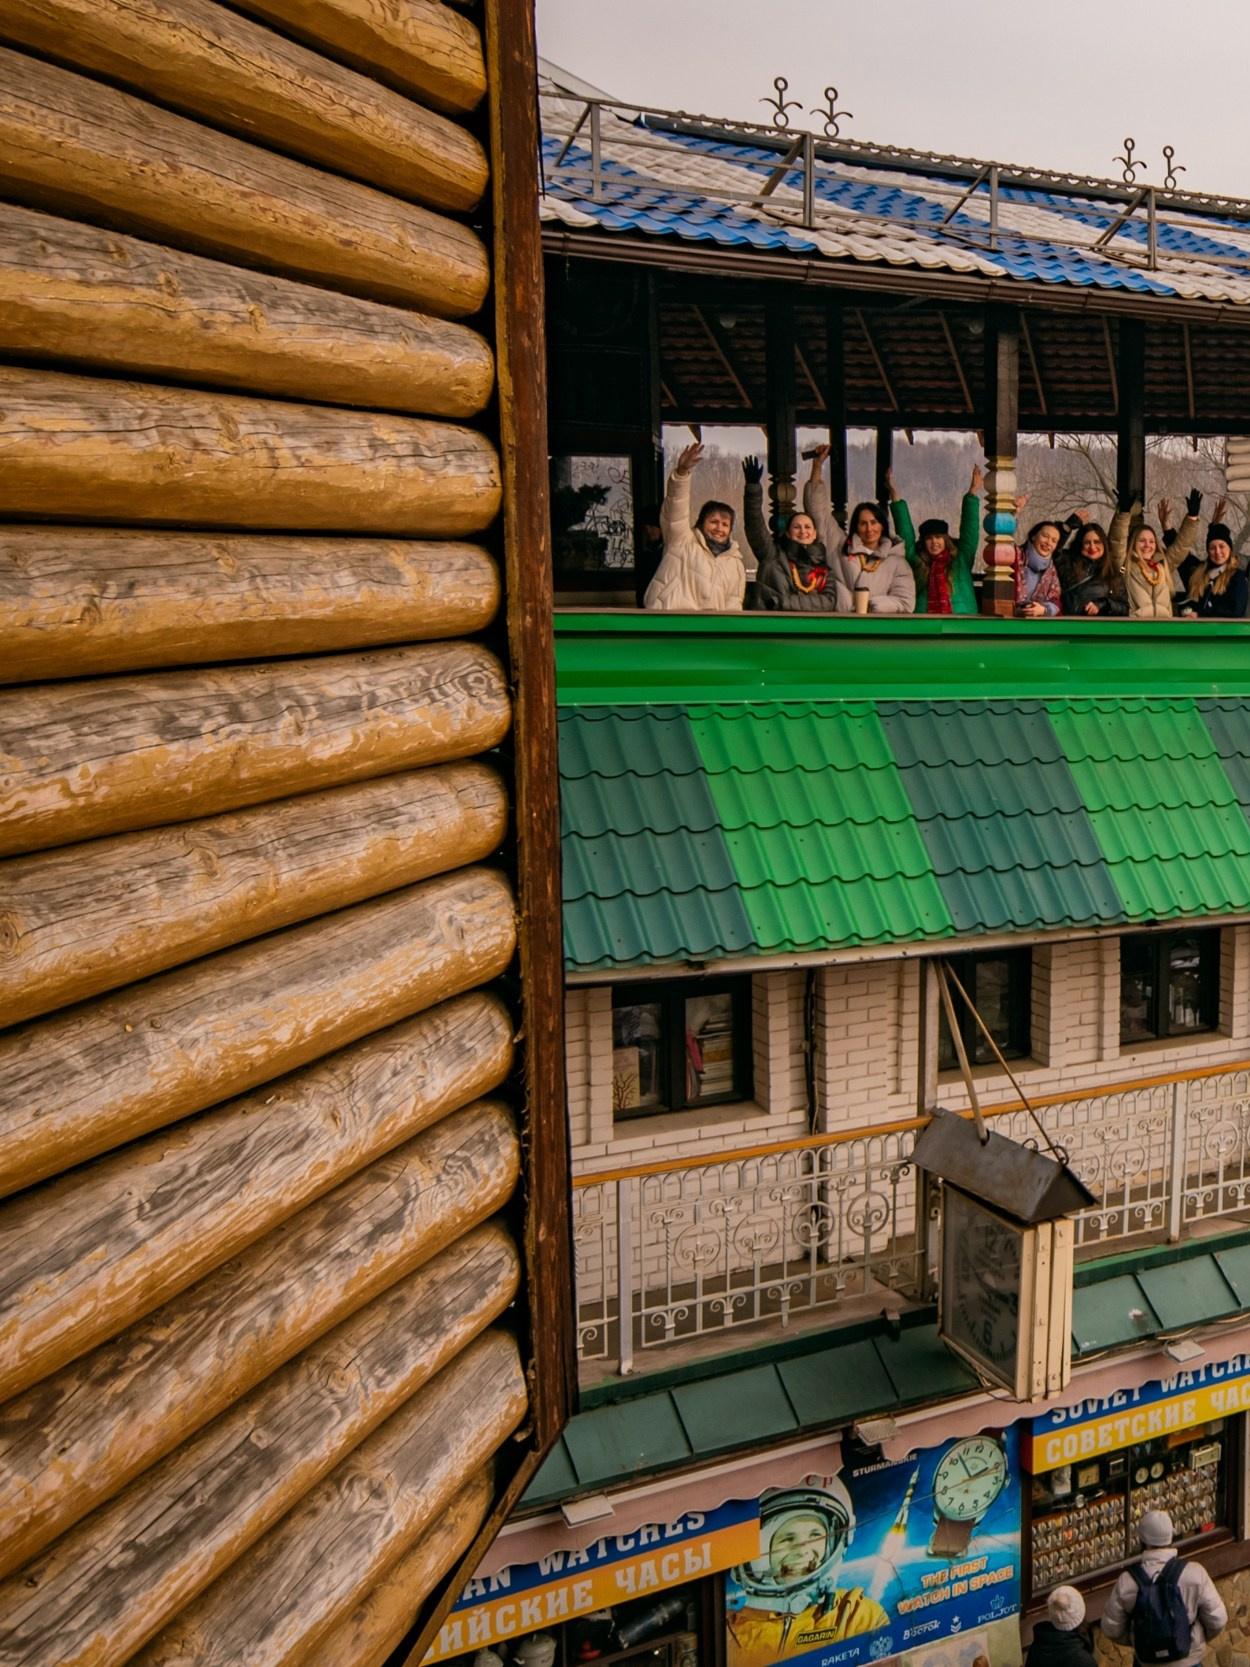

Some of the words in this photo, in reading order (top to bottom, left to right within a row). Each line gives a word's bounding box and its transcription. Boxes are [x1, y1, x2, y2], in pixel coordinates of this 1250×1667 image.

[1045, 1397, 1197, 1464] СОВЕТСКИЕ
[456, 1568, 512, 1604] AN
[537, 1512, 706, 1577] WATCHES
[921, 1567, 949, 1589] THE
[951, 1556, 990, 1580] FIRST
[424, 1579, 594, 1660] ИЙСКИЕ
[614, 1542, 713, 1595] ЧАСЫ
[897, 1585, 950, 1615] WATCH
[952, 1578, 968, 1597] IN
[969, 1564, 1014, 1591] SPACE
[977, 1603, 1018, 1624] POLJOT
[797, 1629, 835, 1645] GAGARIN
[821, 1647, 860, 1667] RAKETA
